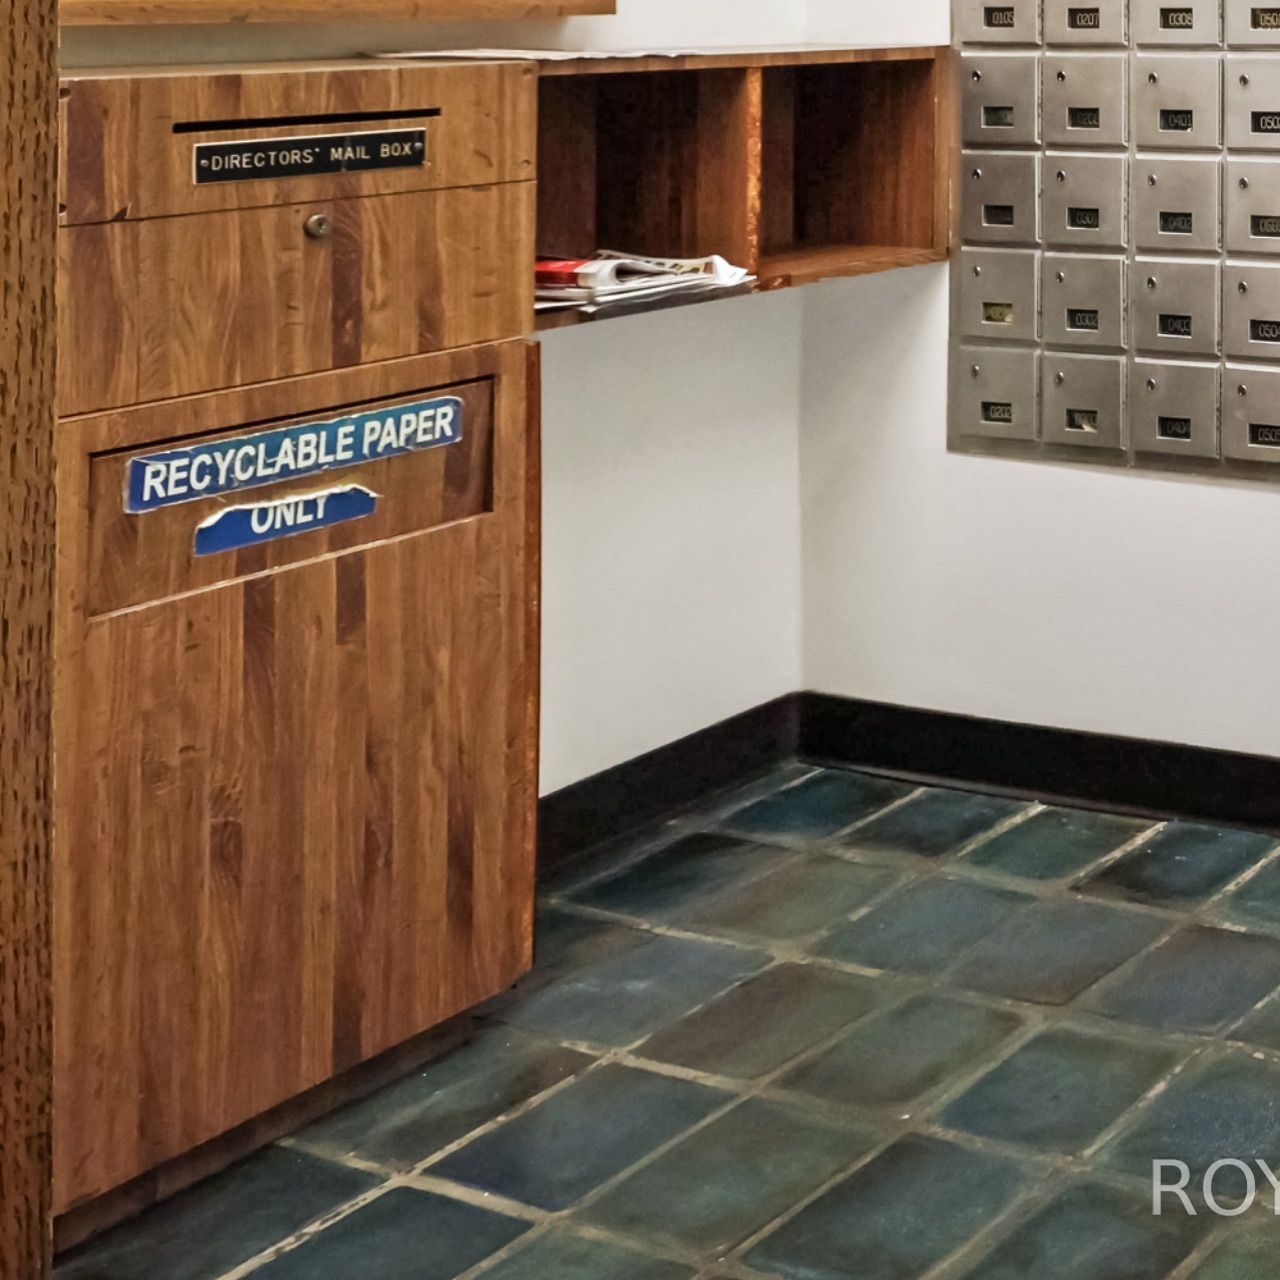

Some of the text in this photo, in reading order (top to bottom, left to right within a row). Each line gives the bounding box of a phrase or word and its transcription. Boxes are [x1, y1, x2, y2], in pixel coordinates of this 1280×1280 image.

[211, 142, 412, 172] DIRECTORS' MAIL BOX
[142, 406, 454, 501] RECYCLABLE PAPER
[250, 496, 327, 535] ONLY
